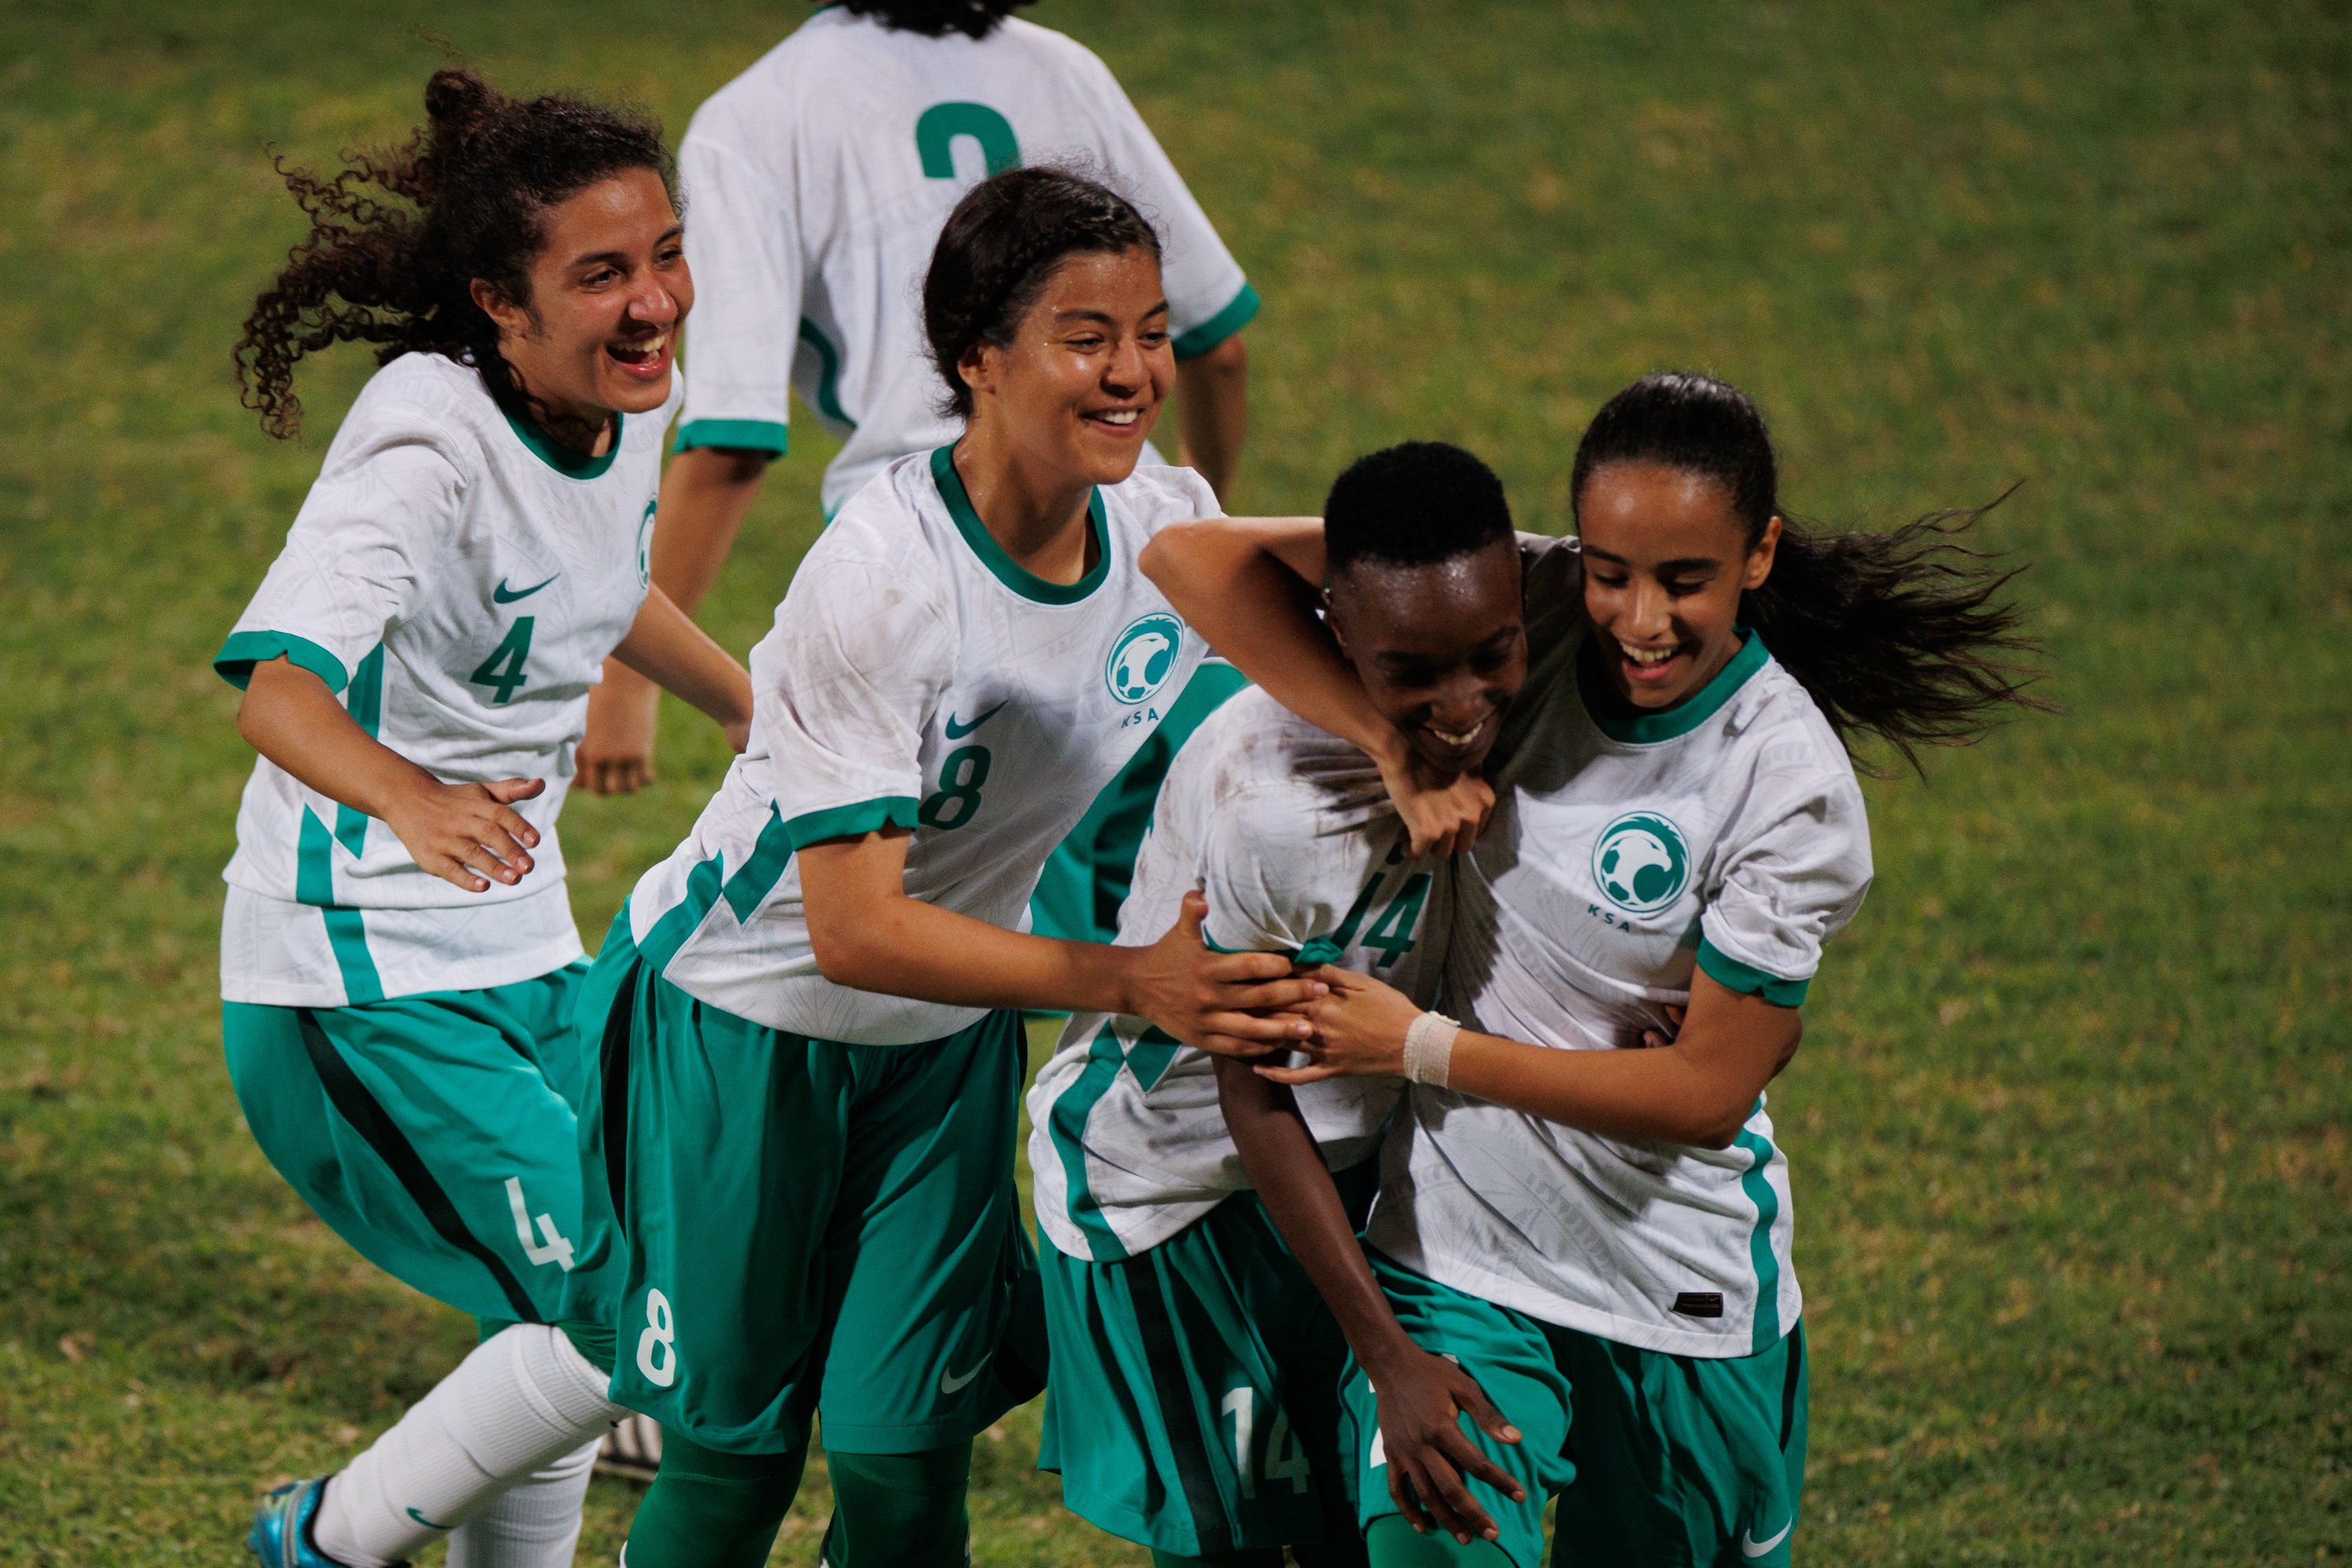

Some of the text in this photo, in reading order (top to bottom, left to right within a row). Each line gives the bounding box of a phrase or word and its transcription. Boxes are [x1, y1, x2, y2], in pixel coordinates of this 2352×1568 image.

[469, 616, 535, 703] 4
[1121, 707, 1159, 728] KSA
[918, 745, 991, 830] 8
[1330, 872, 1432, 968] 14
[1588, 904, 1630, 932] KSA
[504, 1176, 575, 1272] 4
[636, 1288, 676, 1387] 8
[1222, 1387, 1311, 1499] 14
